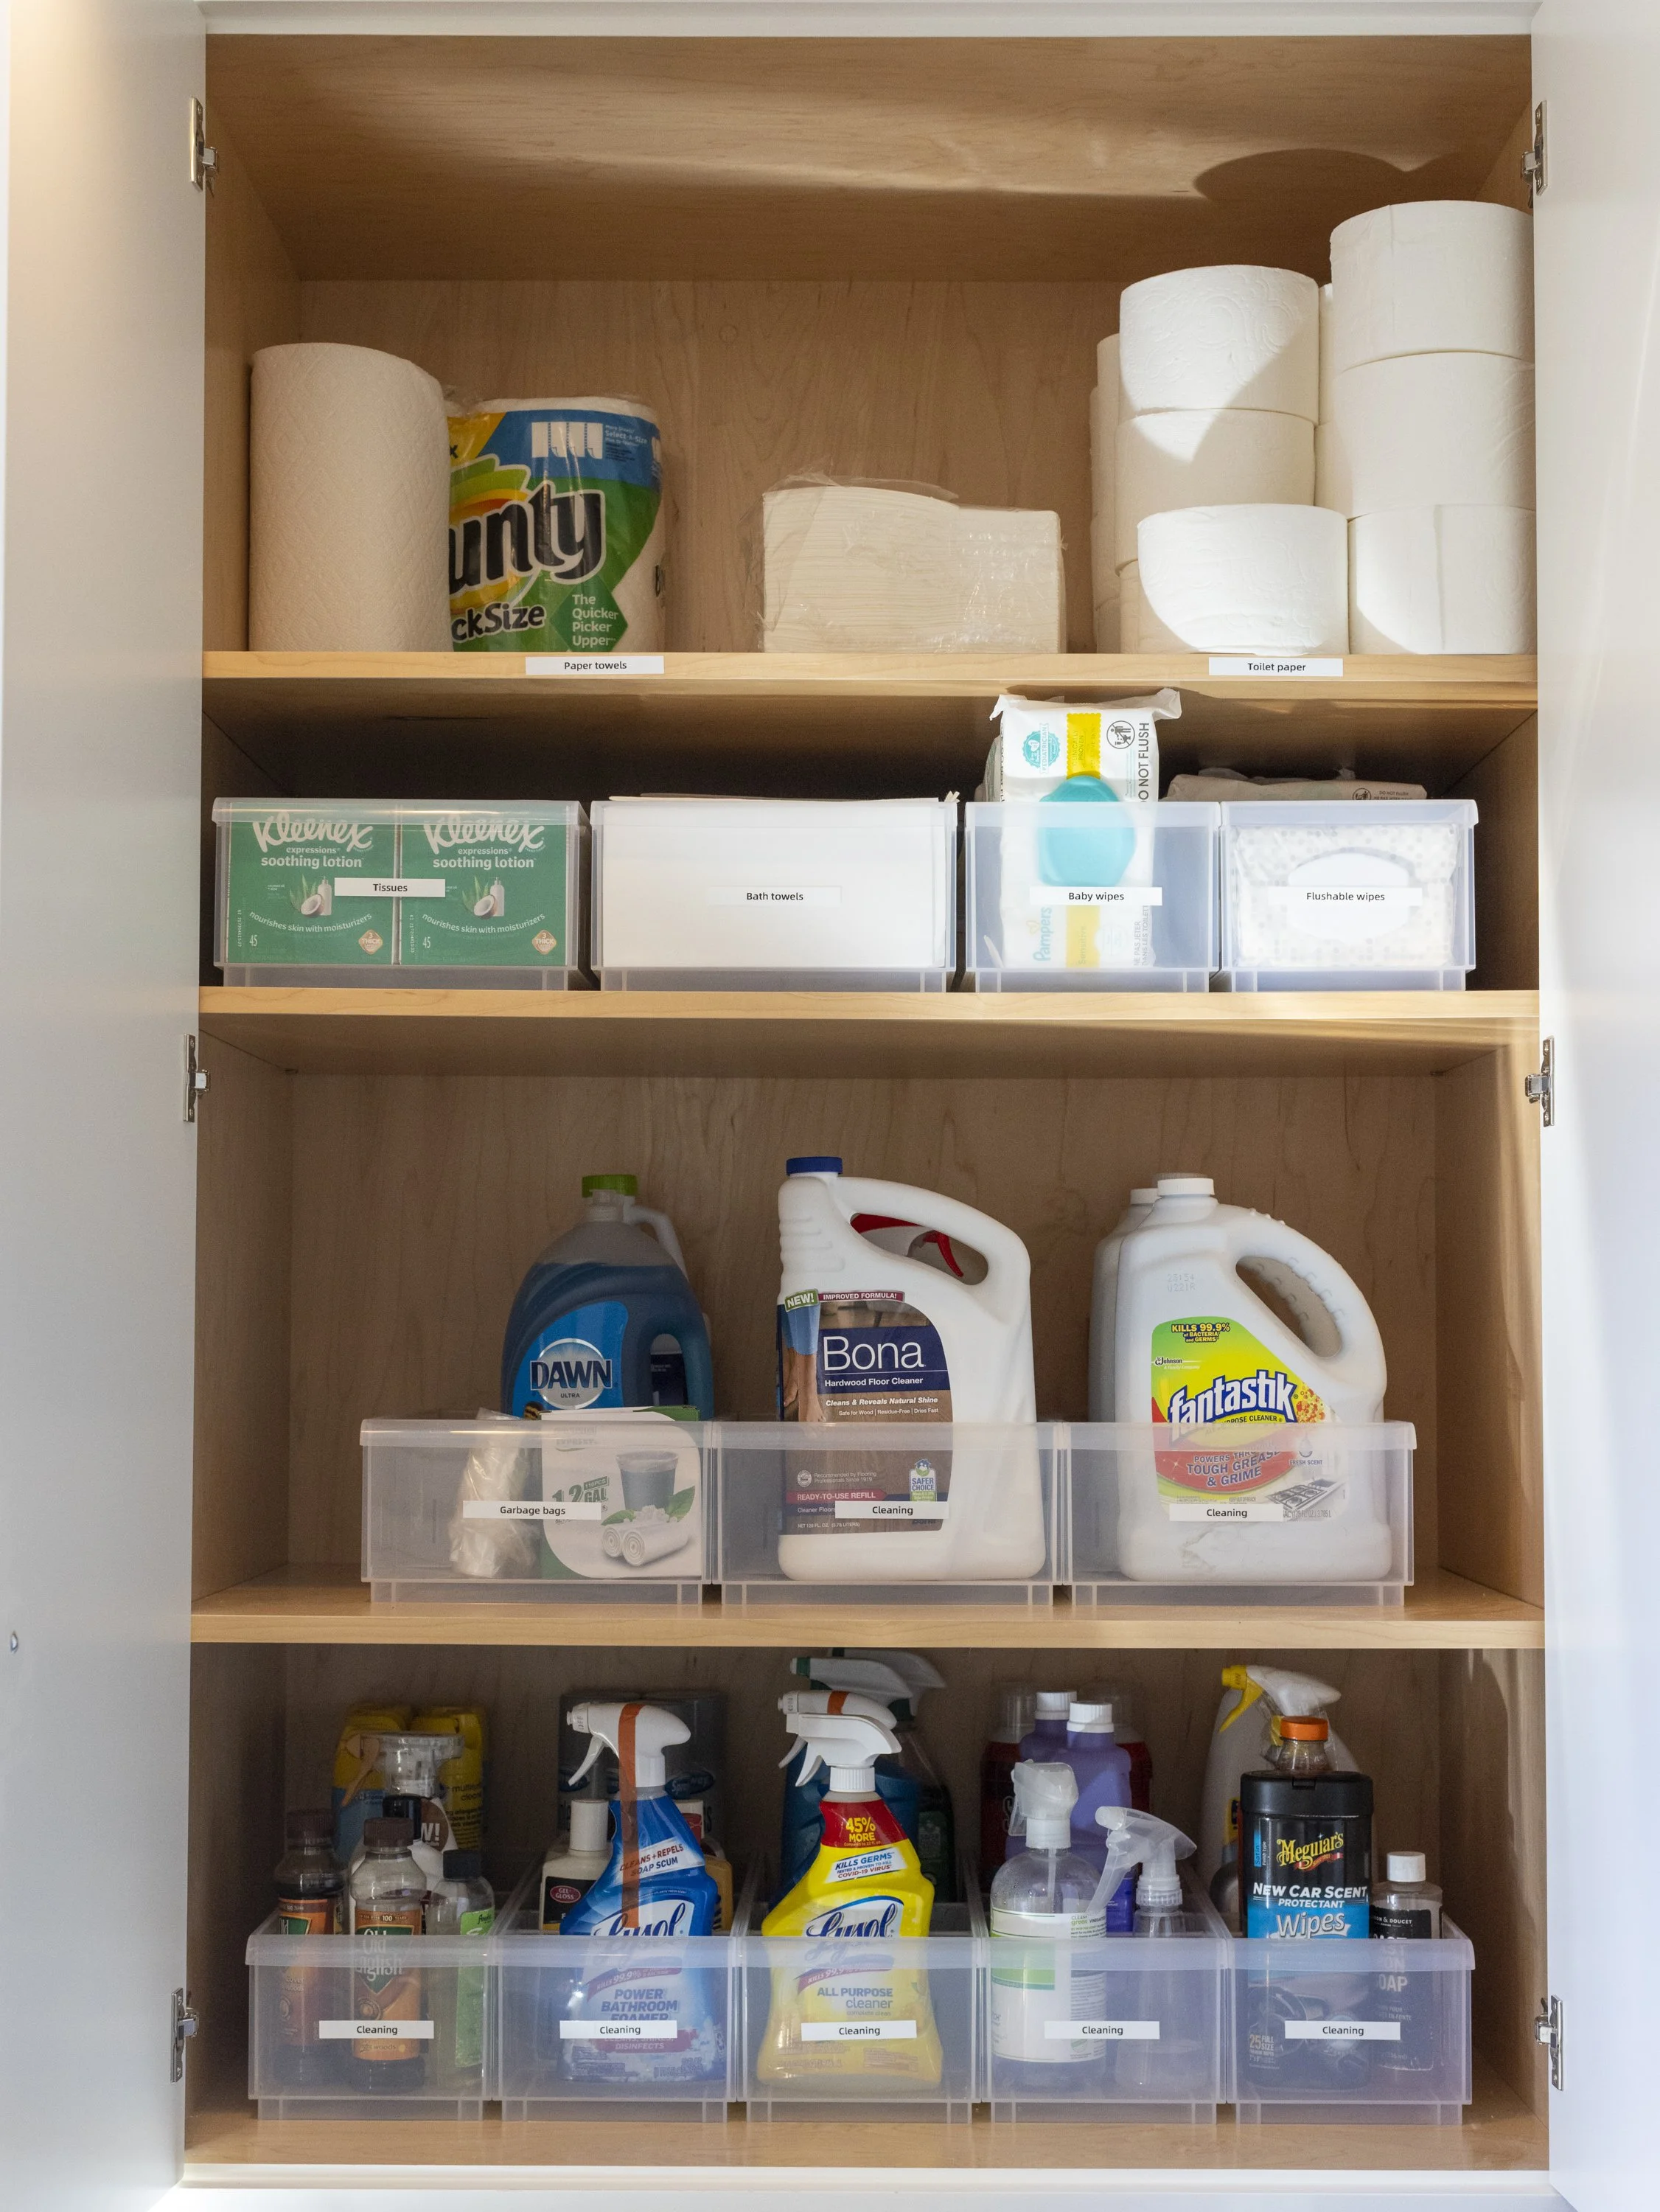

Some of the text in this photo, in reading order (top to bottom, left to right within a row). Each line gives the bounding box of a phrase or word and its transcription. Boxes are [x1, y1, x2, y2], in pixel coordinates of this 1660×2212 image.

[572, 594, 596, 605] The
[572, 608, 618, 621] Quicker
[572, 622, 611, 633] Picker
[572, 635, 610, 647] Upper
[564, 661, 627, 671] Paper towels
[1247, 663, 1306, 673] Toilet paper
[1138, 723, 1149, 786] NOT FLUSH
[252, 811, 373, 853] Kleenex
[423, 815, 545, 855] Kleenex
[261, 855, 362, 869] soothing lotion
[433, 856, 534, 870] soothing lotion
[373, 883, 408, 892] Tissues
[746, 892, 803, 900] Bath towels
[1069, 892, 1124, 902] Baby wipes
[1306, 892, 1385, 902] Flushable wipes
[250, 911, 287, 931] nourishes
[288, 923, 304, 932] skin
[324, 914, 372, 932] moisturizers
[422, 914, 460, 931] nourishes
[461, 924, 477, 933] skin
[497, 914, 545, 933] moisturizers
[1033, 907, 1054, 961] Pampers
[250, 934, 257, 947] 45
[423, 936, 431, 949] 45
[1078, 926, 1087, 965] Sensitive
[787, 1293, 814, 1308] NEW!
[1200, 1323, 1230, 1332] 99.9%
[823, 1335, 924, 1371] Bona
[530, 1359, 612, 1390] DAWN
[825, 1379, 866, 1387] Hardwood
[868, 1378, 890, 1386] Floor
[1170, 1370, 1294, 1436] fantastik
[1195, 1455, 1230, 1463] POWERS
[1187, 1464, 1228, 1475] TOUGH
[1207, 1466, 1262, 1487] & GRIME
[585, 1488, 607, 1502] GAL
[797, 1493, 850, 1501] READY-TO-USE
[500, 1506, 566, 1517] Garbage bags
[872, 1506, 914, 1516] Cleaning
[1207, 1509, 1248, 1519] Cleaning
[846, 1817, 876, 1833] 45%
[849, 1832, 876, 1842] MORE
[1276, 1832, 1344, 1870] Meguiar's
[656, 1857, 678, 1869] SCUM
[835, 1859, 859, 1870] KILLS
[838, 1869, 868, 1878] COVID-19
[1253, 1882, 1367, 1899] NEW CAR SCENT
[1278, 1899, 1345, 1909] PROTECTANT
[1276, 1911, 1345, 1938] Wipes
[364, 1928, 387, 1954] Old
[596, 1970, 642, 1990] KILLS 99.9%
[808, 1972, 825, 1984] KILLS
[614, 1989, 663, 2000] POWER
[817, 1987, 893, 1997] ALL PURPOSE
[601, 2000, 678, 2012] BATHROOM
[846, 1997, 893, 2008] cleaner
[357, 2024, 398, 2035] Cleaning
[600, 2025, 641, 2035] Cleaning
[839, 2027, 880, 2036] Cleaning
[1082, 2026, 1123, 2036] Cleaning
[1322, 2026, 1364, 2036] Cleaning
[1249, 2034, 1274, 2050] 25 FULL
